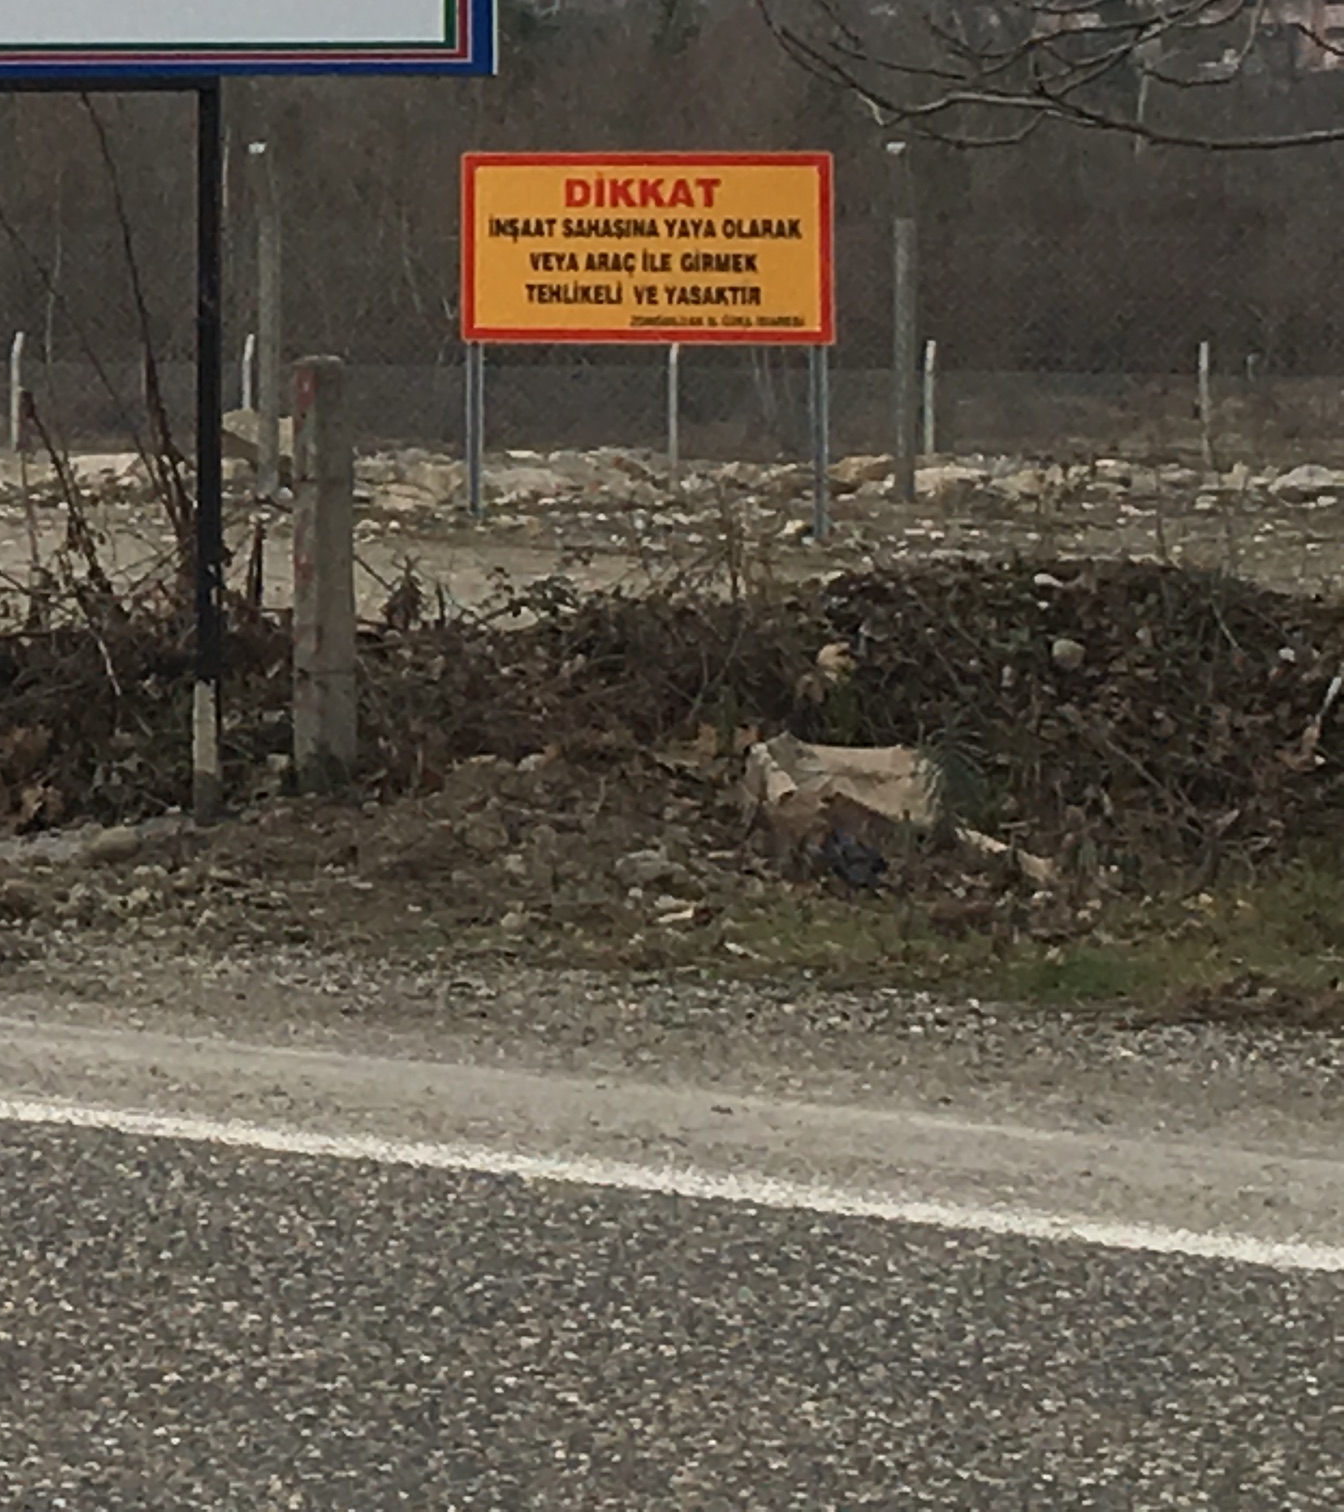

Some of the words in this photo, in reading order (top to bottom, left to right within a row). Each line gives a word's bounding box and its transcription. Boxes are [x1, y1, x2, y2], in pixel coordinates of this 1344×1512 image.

[564, 172, 722, 208] DİKKAT
[488, 213, 557, 244] İNŞAAT
[664, 218, 717, 239] YAYA
[721, 218, 803, 239] OLARAK
[530, 251, 579, 272] VEYA
[585, 251, 636, 278] ARAÇ
[641, 248, 673, 272] İLE
[525, 280, 623, 305] TEHLİKELİ
[633, 285, 659, 305] VE
